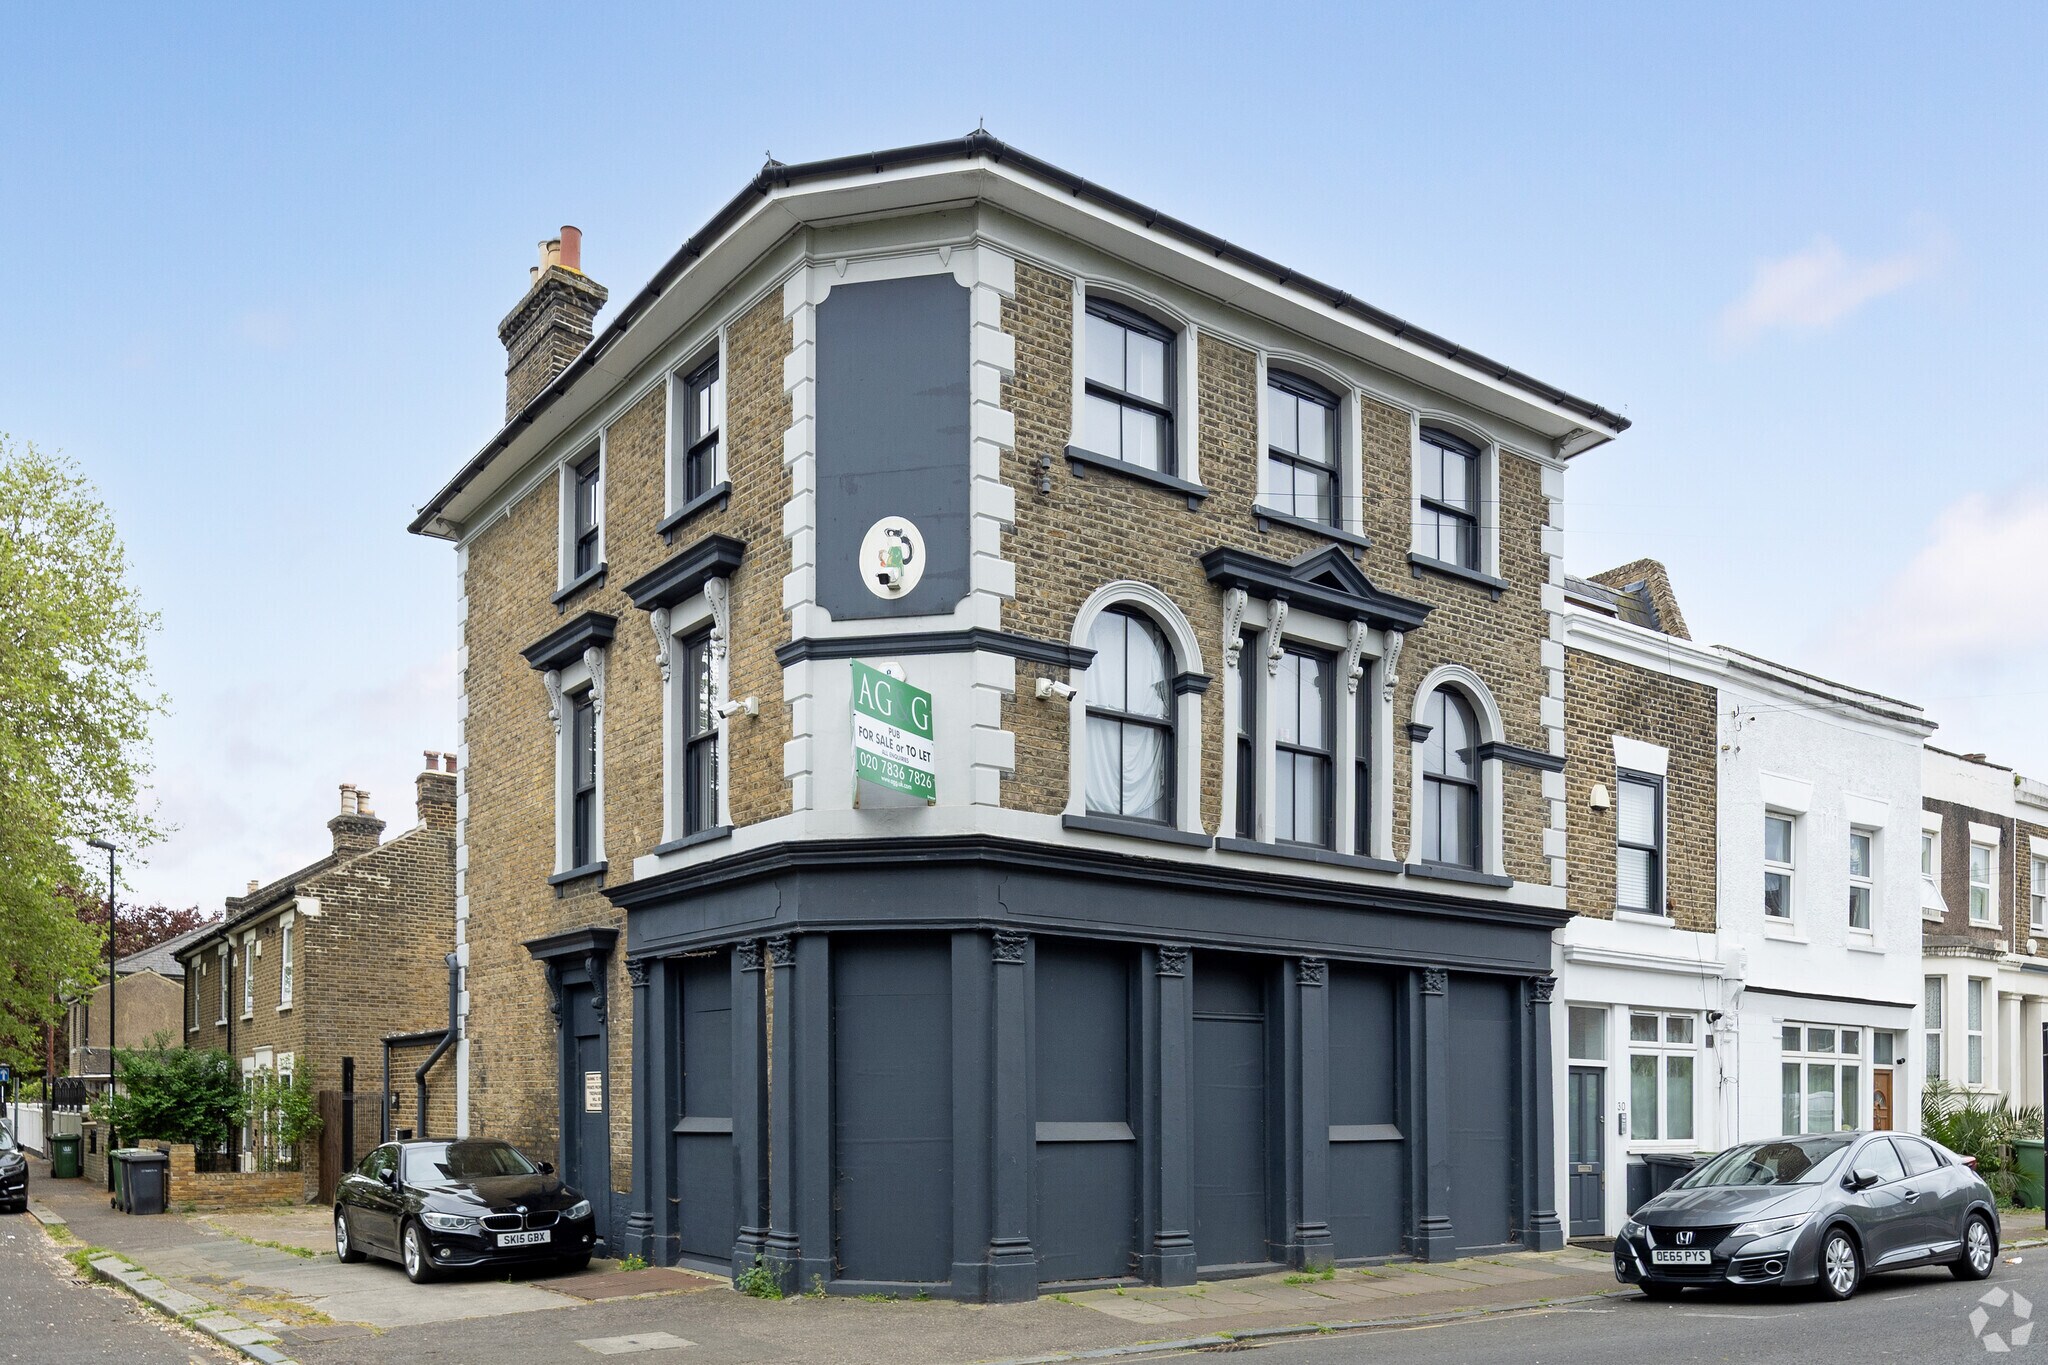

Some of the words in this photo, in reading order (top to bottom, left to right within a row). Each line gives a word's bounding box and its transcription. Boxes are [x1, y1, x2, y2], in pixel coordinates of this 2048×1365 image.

[888, 727, 901, 739] PUB
[858, 725, 874, 742] FOR
[875, 733, 894, 750] SALE
[895, 744, 904, 753] or
[905, 744, 917, 758] TO
[919, 748, 931, 763] LET
[860, 751, 878, 771] 020
[881, 759, 905, 780] 7836
[908, 769, 932, 789] 7826
[503, 1234, 525, 1245] SK15
[527, 1232, 545, 1243] GBX
[1684, 1251, 1706, 1262] PYS
